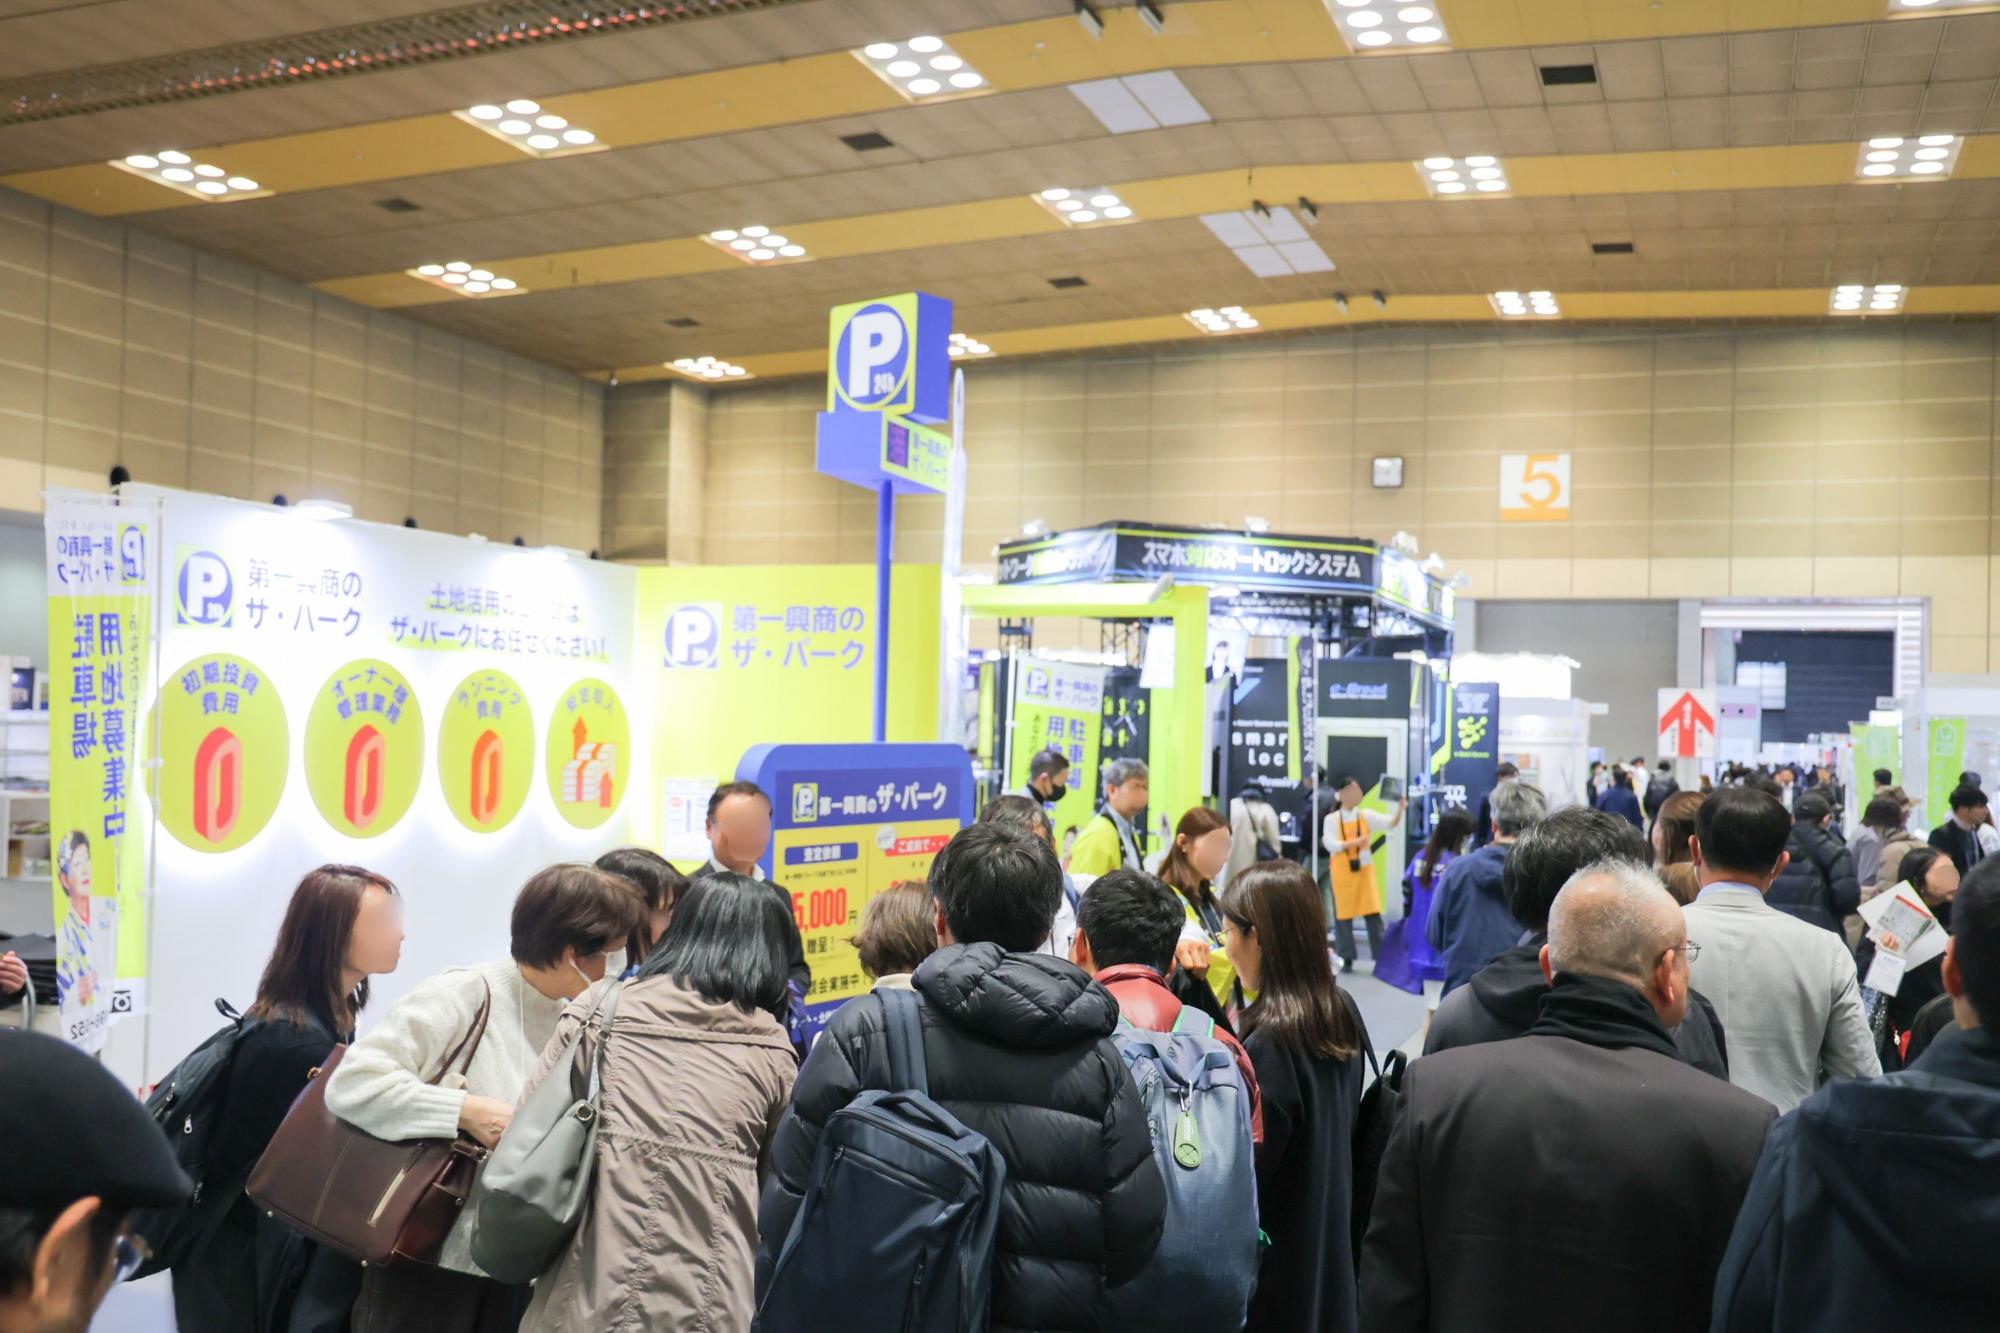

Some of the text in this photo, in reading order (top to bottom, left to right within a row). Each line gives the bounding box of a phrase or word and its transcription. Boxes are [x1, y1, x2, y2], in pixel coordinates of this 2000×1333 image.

[850, 311, 903, 398] P
[1520, 453, 1561, 508] 5
[733, 606, 865, 633] 第一興商の
[731, 638, 865, 670] ザ・パーク
[1232, 731, 1289, 746] smar
[1248, 747, 1286, 767] loc
